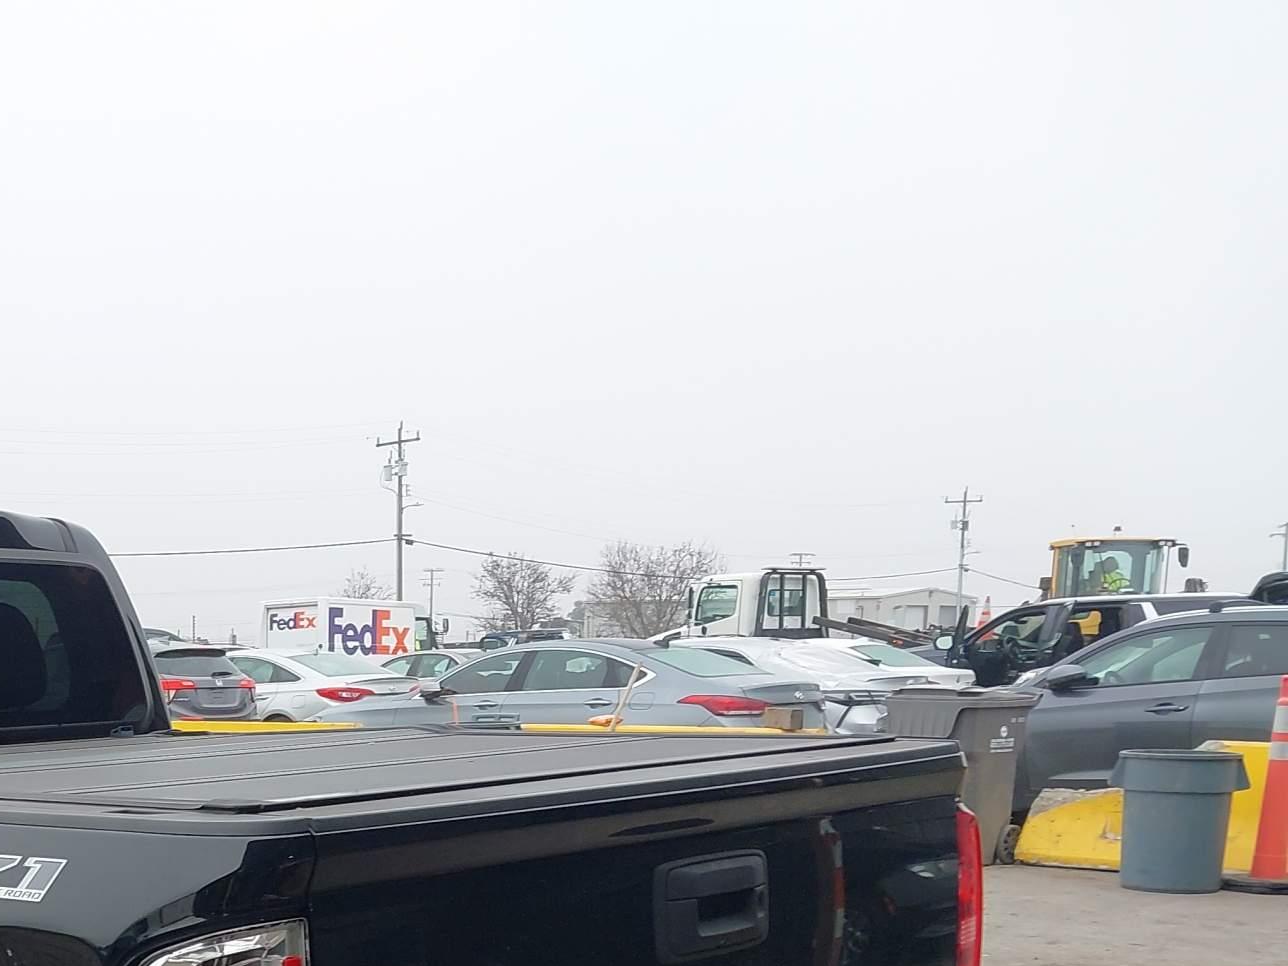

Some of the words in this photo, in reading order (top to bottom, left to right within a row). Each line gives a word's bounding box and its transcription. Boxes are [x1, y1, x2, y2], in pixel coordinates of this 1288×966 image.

[269, 612, 318, 631] FedEx
[328, 607, 410, 656] FedEx
[3, 889, 43, 901] ROAD
